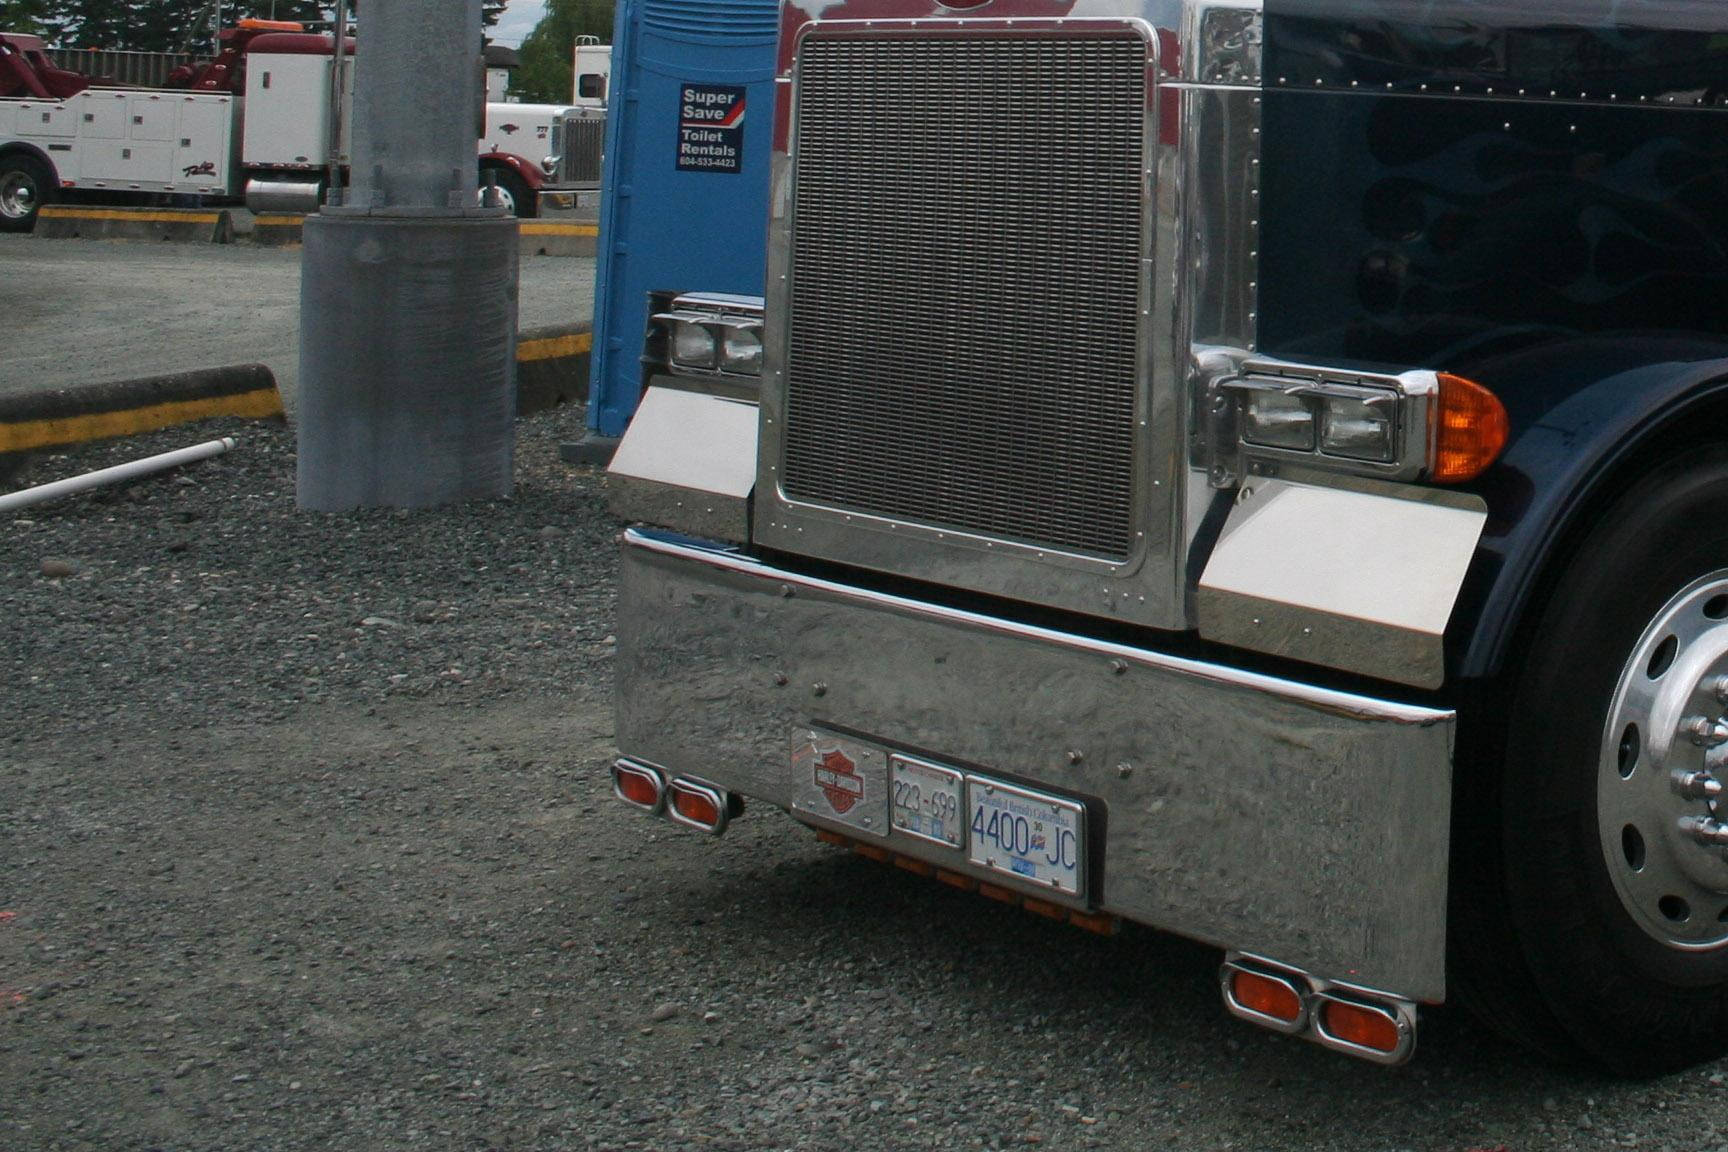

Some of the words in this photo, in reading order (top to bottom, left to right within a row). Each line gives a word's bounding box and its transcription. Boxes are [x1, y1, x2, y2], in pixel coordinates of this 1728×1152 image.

[683, 89, 735, 106] Super
[683, 105, 725, 120] Save
[682, 129, 723, 142] Toilet
[681, 143, 736, 157] Rentals
[971, 805, 1029, 856] 4400
[1046, 826, 1076, 870] JC
